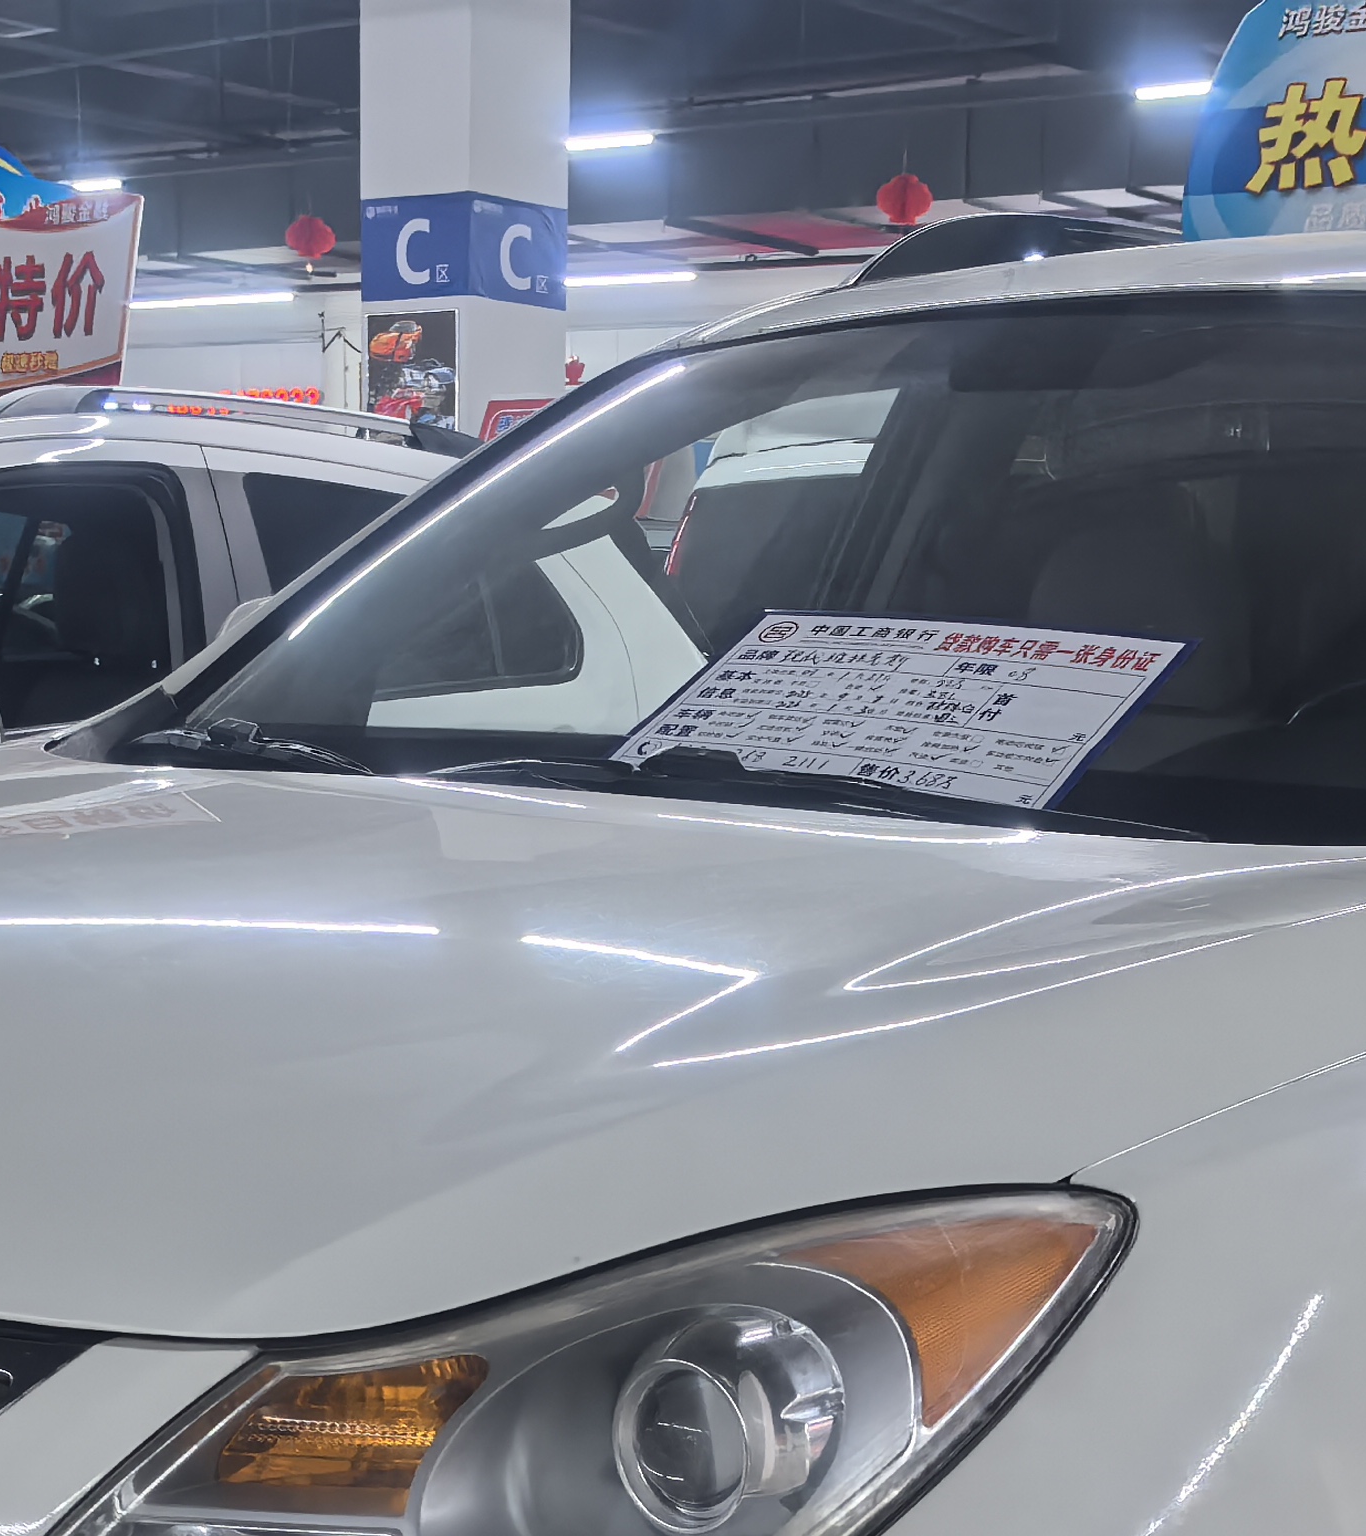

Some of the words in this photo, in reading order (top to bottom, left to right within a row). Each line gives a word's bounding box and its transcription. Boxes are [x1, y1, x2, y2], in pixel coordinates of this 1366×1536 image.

[736, 648, 779, 661] 品牌
[811, 624, 939, 642] 中国工商银行
[934, 632, 1162, 671] 贷款购车只需一张身份证
[714, 669, 758, 682] 基本
[956, 661, 998, 677] 年限
[695, 685, 737, 700] 信息
[673, 707, 716, 721] 车辆
[654, 723, 699, 738] 配置
[1069, 731, 1087, 743] 元
[856, 763, 900, 781] 售价
[1015, 794, 1033, 806] 元
